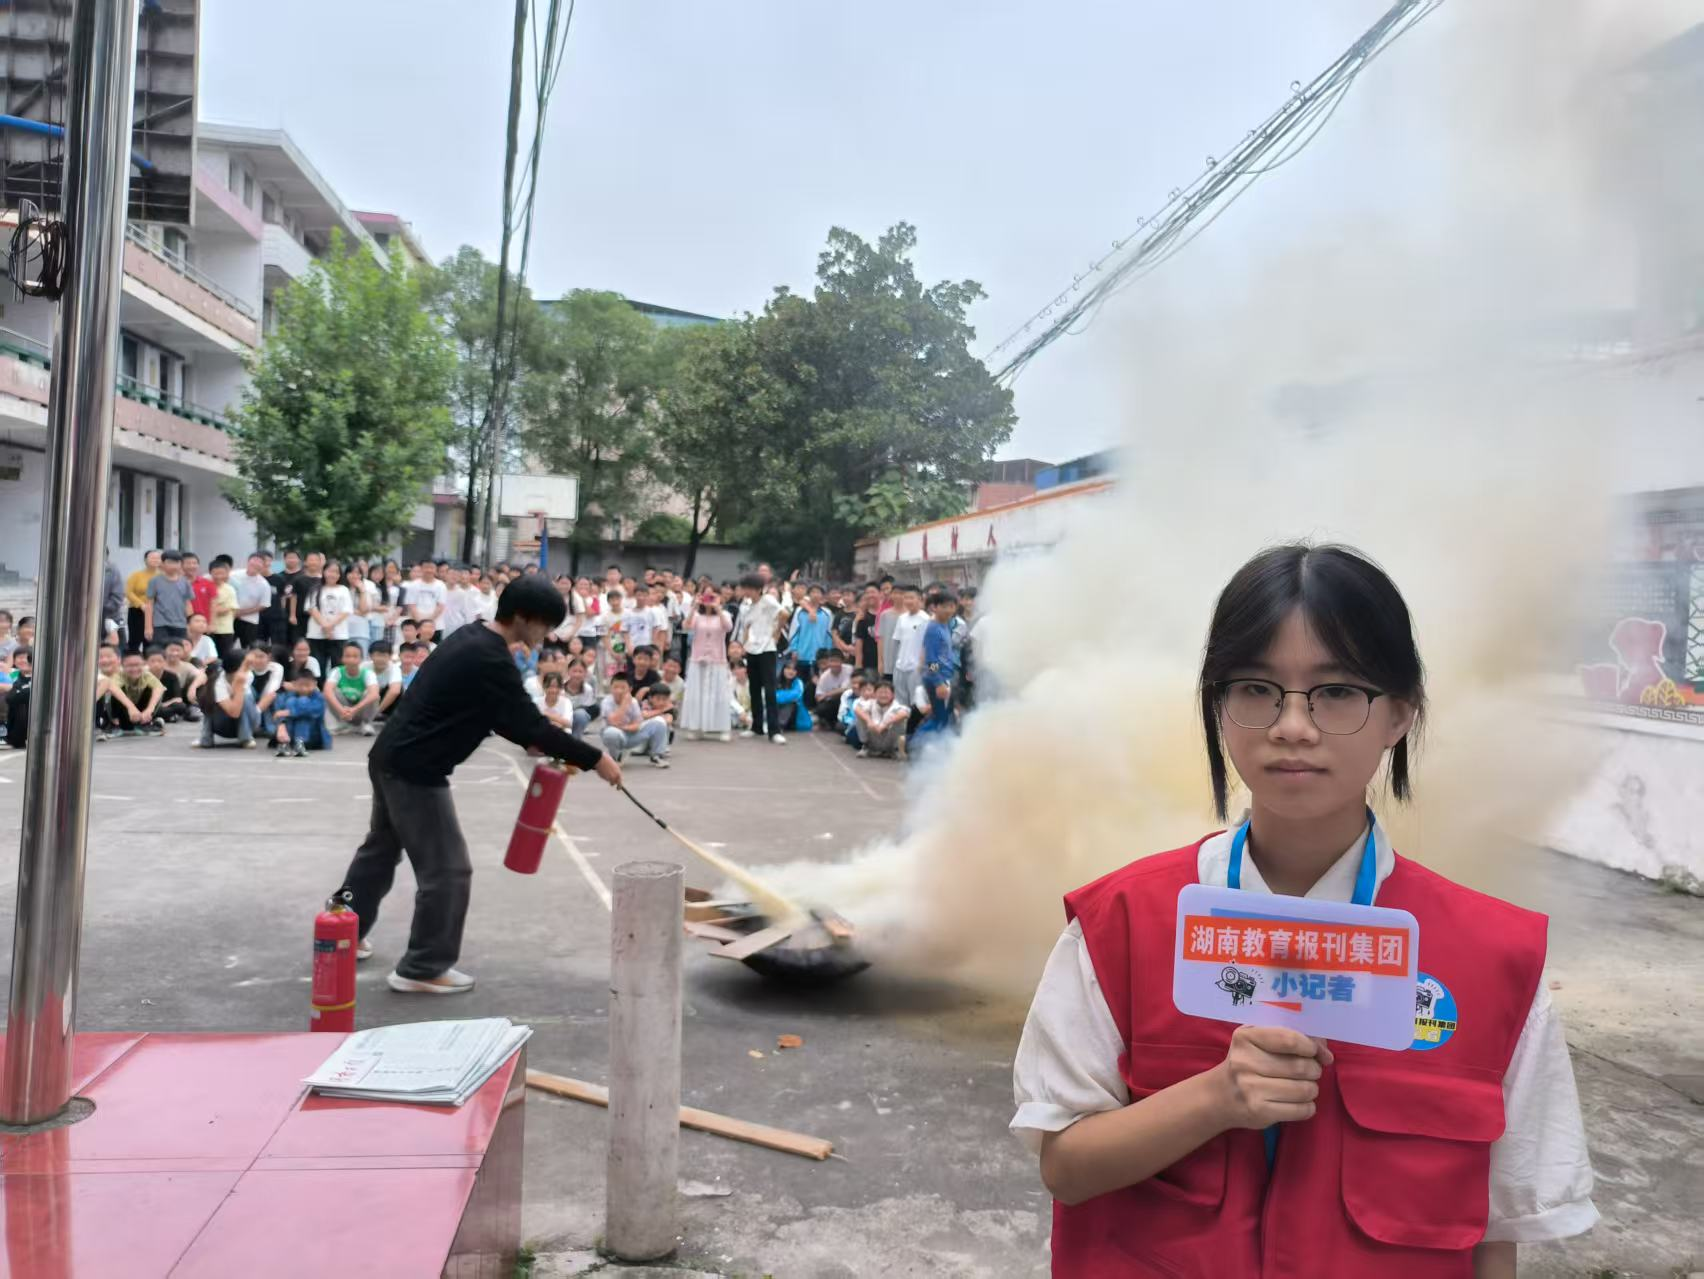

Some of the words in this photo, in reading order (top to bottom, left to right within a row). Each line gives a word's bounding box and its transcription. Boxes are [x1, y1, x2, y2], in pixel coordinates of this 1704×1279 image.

[1190, 925, 1403, 966] 湖南教育报刊集团
[1271, 971, 1356, 1003] 小记者
